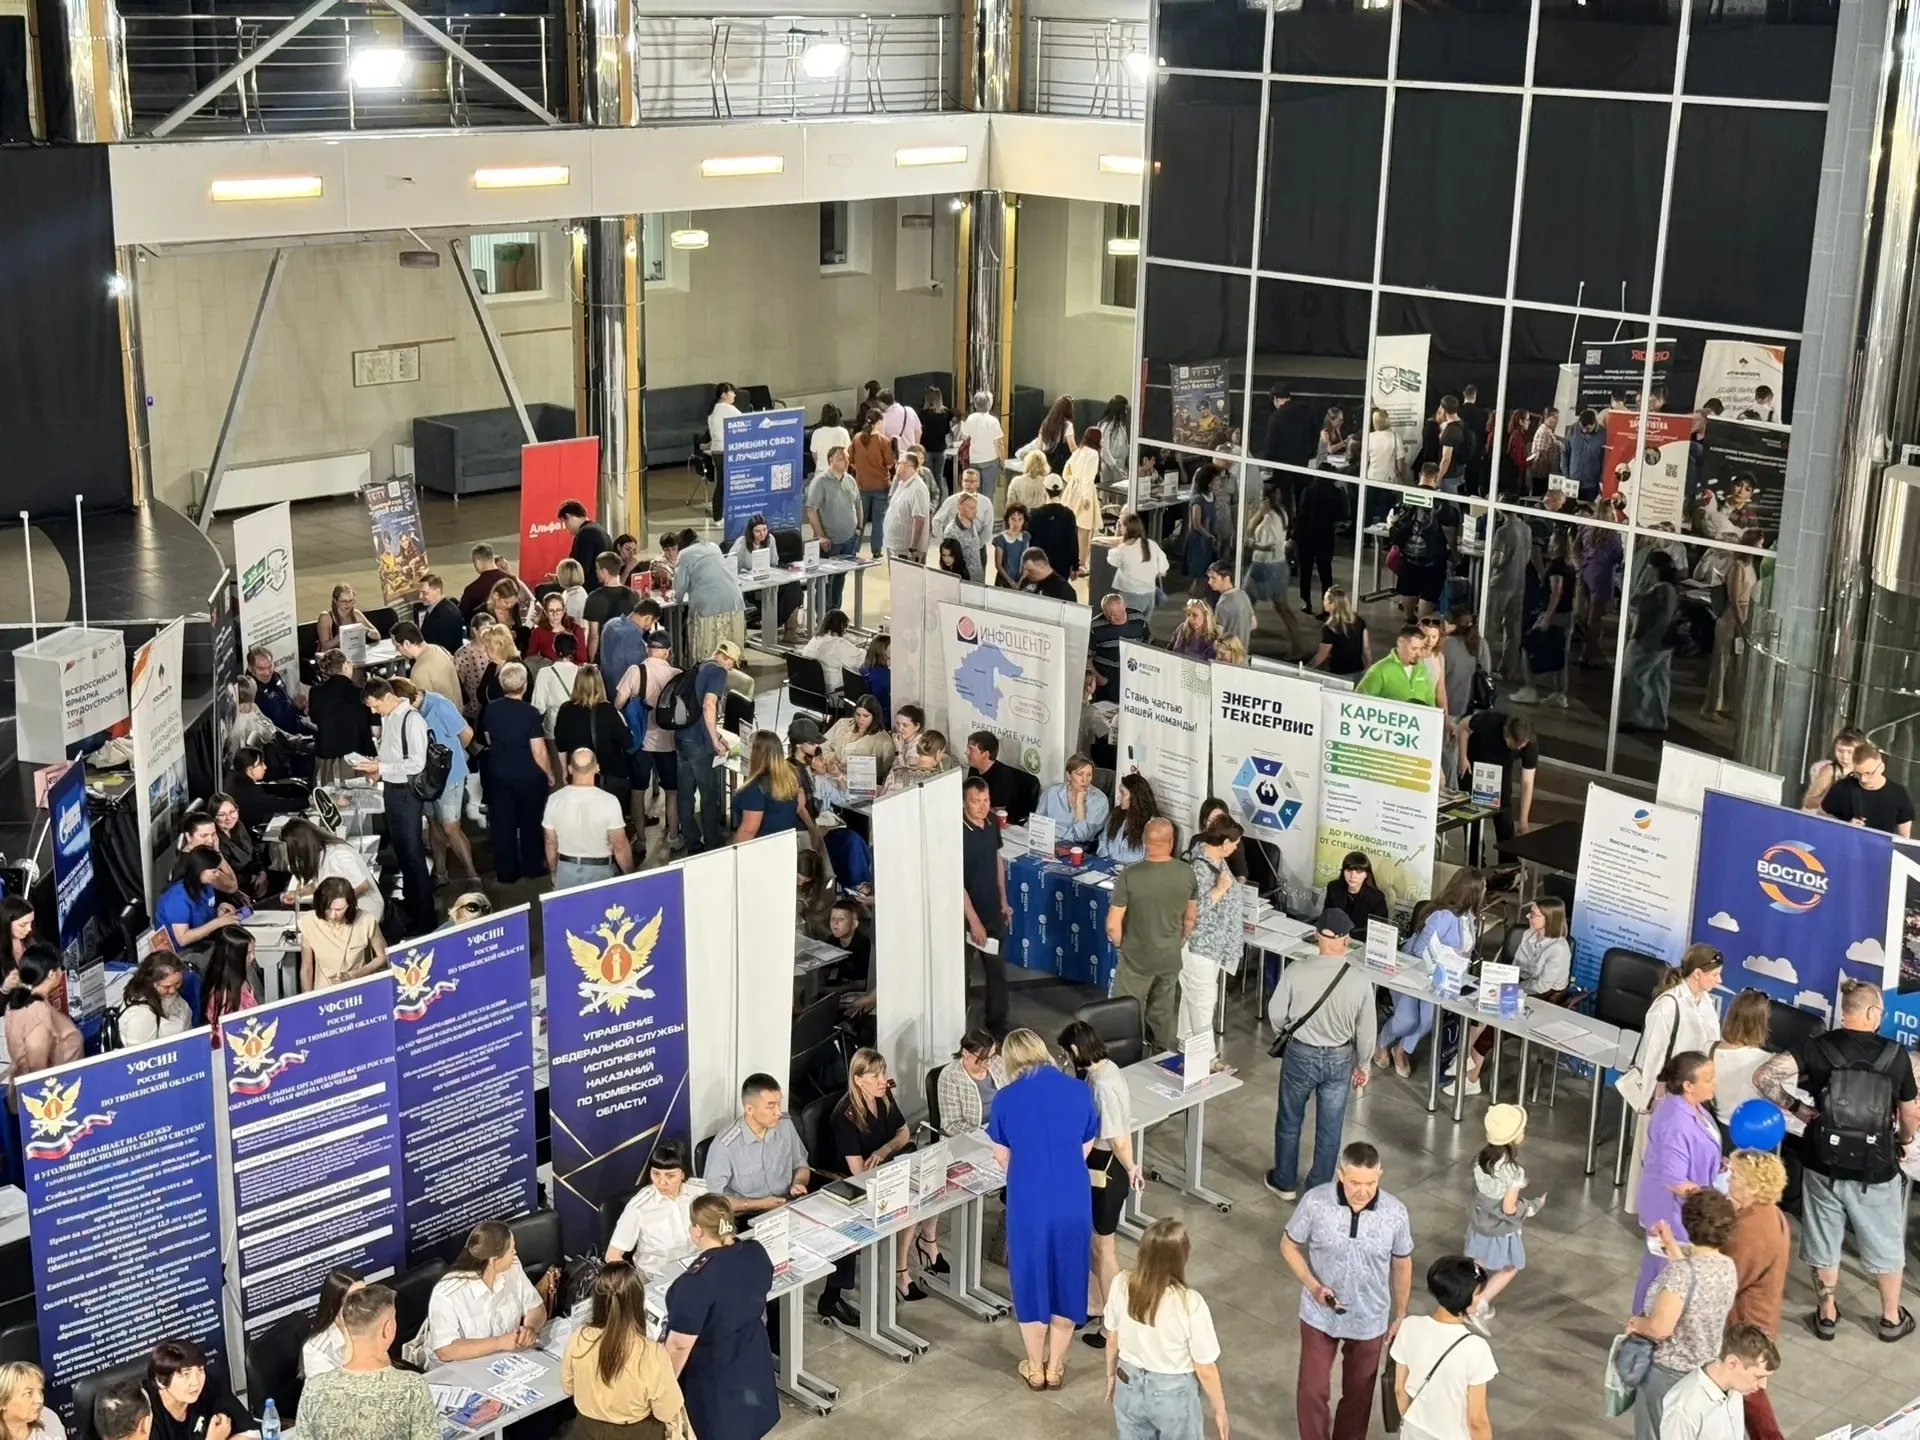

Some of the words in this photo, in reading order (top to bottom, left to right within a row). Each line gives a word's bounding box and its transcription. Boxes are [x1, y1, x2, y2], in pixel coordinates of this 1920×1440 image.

[728, 439, 768, 451] ИЗМЕНИМ
[769, 436, 795, 446] СВЯЗЬ
[735, 449, 776, 462] ЛУЧШЕМУ
[529, 521, 561, 534] Альфа
[979, 625, 1050, 656] ИНФОЦЕНТР
[65, 669, 119, 699] ВСЕРОССИЙСКАЯ
[65, 689, 99, 707] ЯРМАРКА
[66, 687, 125, 719] ТРУДОУСТРОЙСТВА
[1124, 688, 1149, 705] Стань
[1151, 697, 1183, 714] частью
[1222, 690, 1282, 715] ЭНЕРГО
[1124, 702, 1153, 720] нашей
[1154, 711, 1198, 733] команды!
[1340, 702, 1420, 732] КАРЬЕРА
[971, 721, 1017, 741] РАБОТАЙТЕ
[1020, 731, 1025, 741] У
[1027, 733, 1041, 748] НАС
[1339, 721, 1350, 736] В
[1359, 723, 1420, 750] УСТЭК
[1319, 837, 1330, 848] ОТ
[1331, 839, 1392, 860] СПЕЦИАЛИСТА
[1328, 828, 1341, 839] ДО
[1343, 831, 1408, 852] РУКОВОДИТЕЛЯ
[1757, 859, 1830, 890] ВОСТОК
[467, 925, 504, 947] УФСИН
[318, 993, 362, 1017] УФСИН
[295, 1036, 306, 1047] ПО
[355, 1012, 387, 1029] ОБЛАСТИ
[326, 1011, 355, 1026] РОССИИ
[583, 1016, 654, 1042] УПРАВЛЕНИЕ
[552, 1034, 634, 1066] ФЕДЕРАЛЬНОЙ
[636, 1023, 684, 1044] СЛУЖБЫ
[126, 1050, 177, 1075] УФСИН
[583, 1046, 656, 1073] ИСПОЛНЕНИЯ
[136, 1069, 169, 1085] РОССИИ
[586, 1061, 654, 1089] НАКАЗАНИЙ
[100, 1096, 113, 1108] ПО
[115, 1081, 167, 1104] ТЮМЕНСКОЙ
[169, 1070, 205, 1088] ОБЛАСТИ
[577, 1094, 592, 1107] ПО
[595, 1075, 663, 1103] ТЮМЕНСКОЙ
[596, 1096, 647, 1118] ОБЛАСТИ
